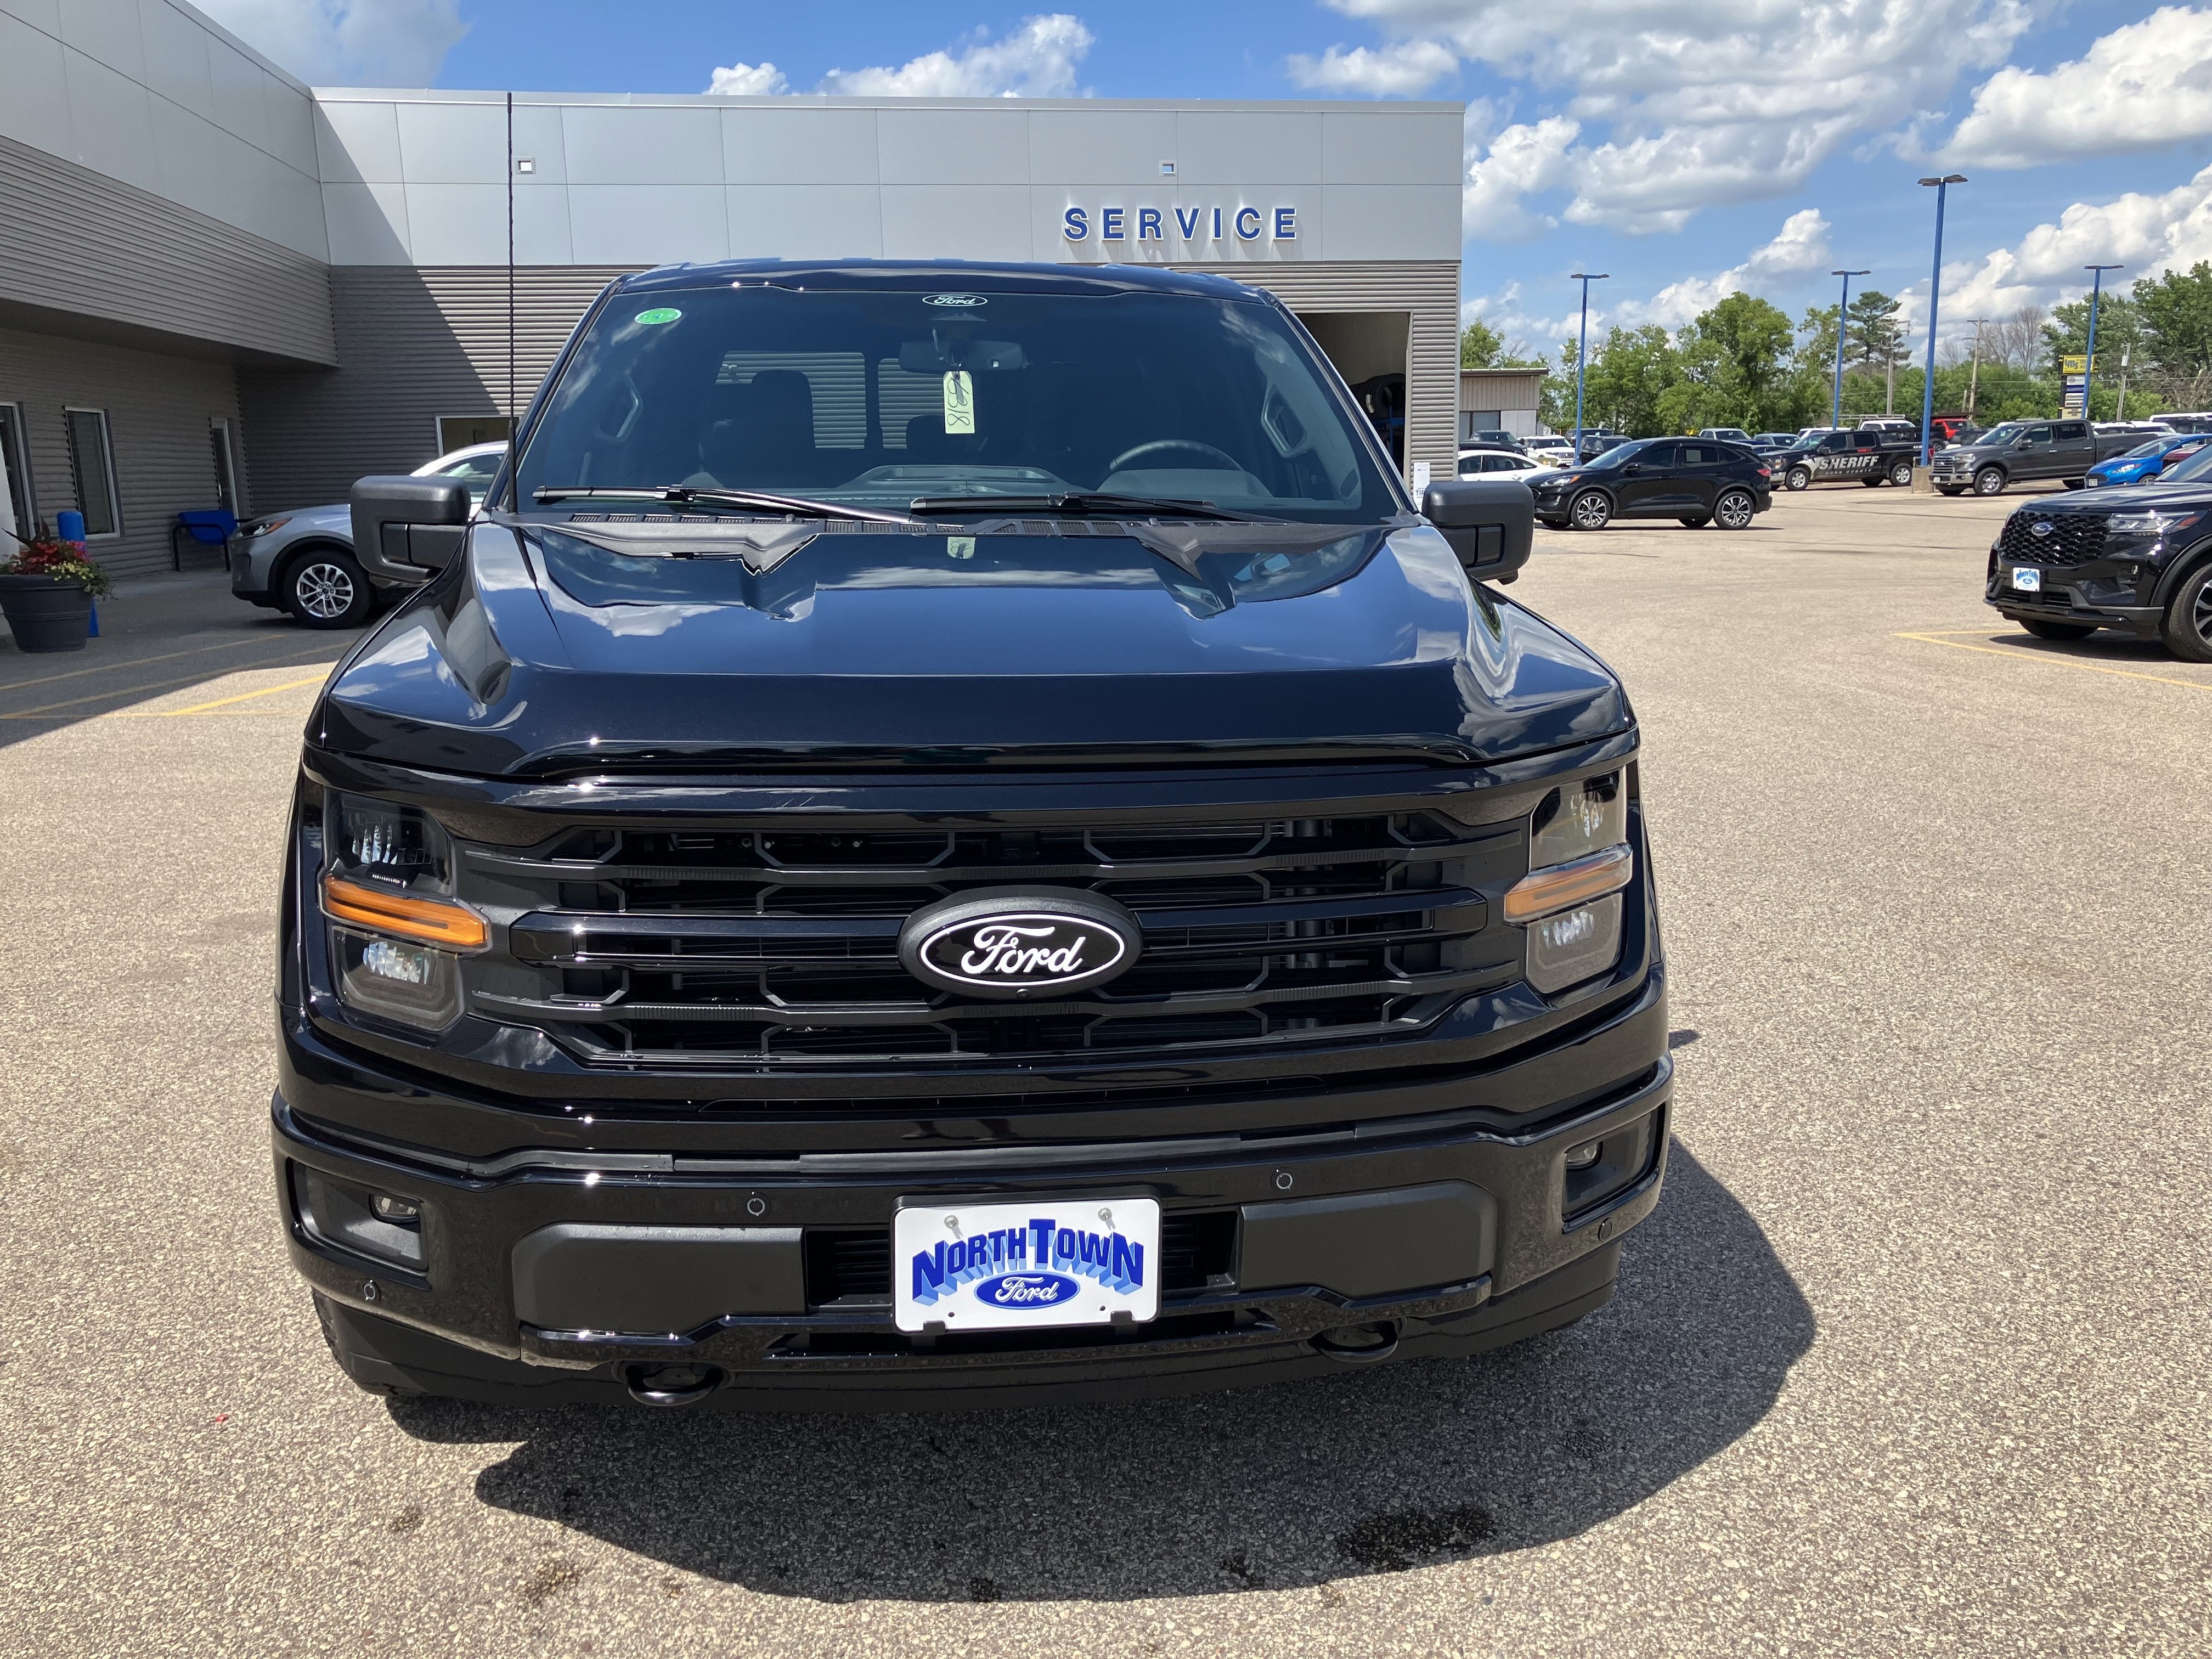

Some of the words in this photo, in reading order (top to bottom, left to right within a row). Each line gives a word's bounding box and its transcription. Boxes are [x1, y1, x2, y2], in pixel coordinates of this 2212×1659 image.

[1063, 206, 1296, 240] SERVICE
[934, 296, 976, 304] Ford
[1819, 455, 1879, 470] SHERIFF
[961, 926, 1086, 974] Ford
[995, 1277, 1059, 1302] Ford
